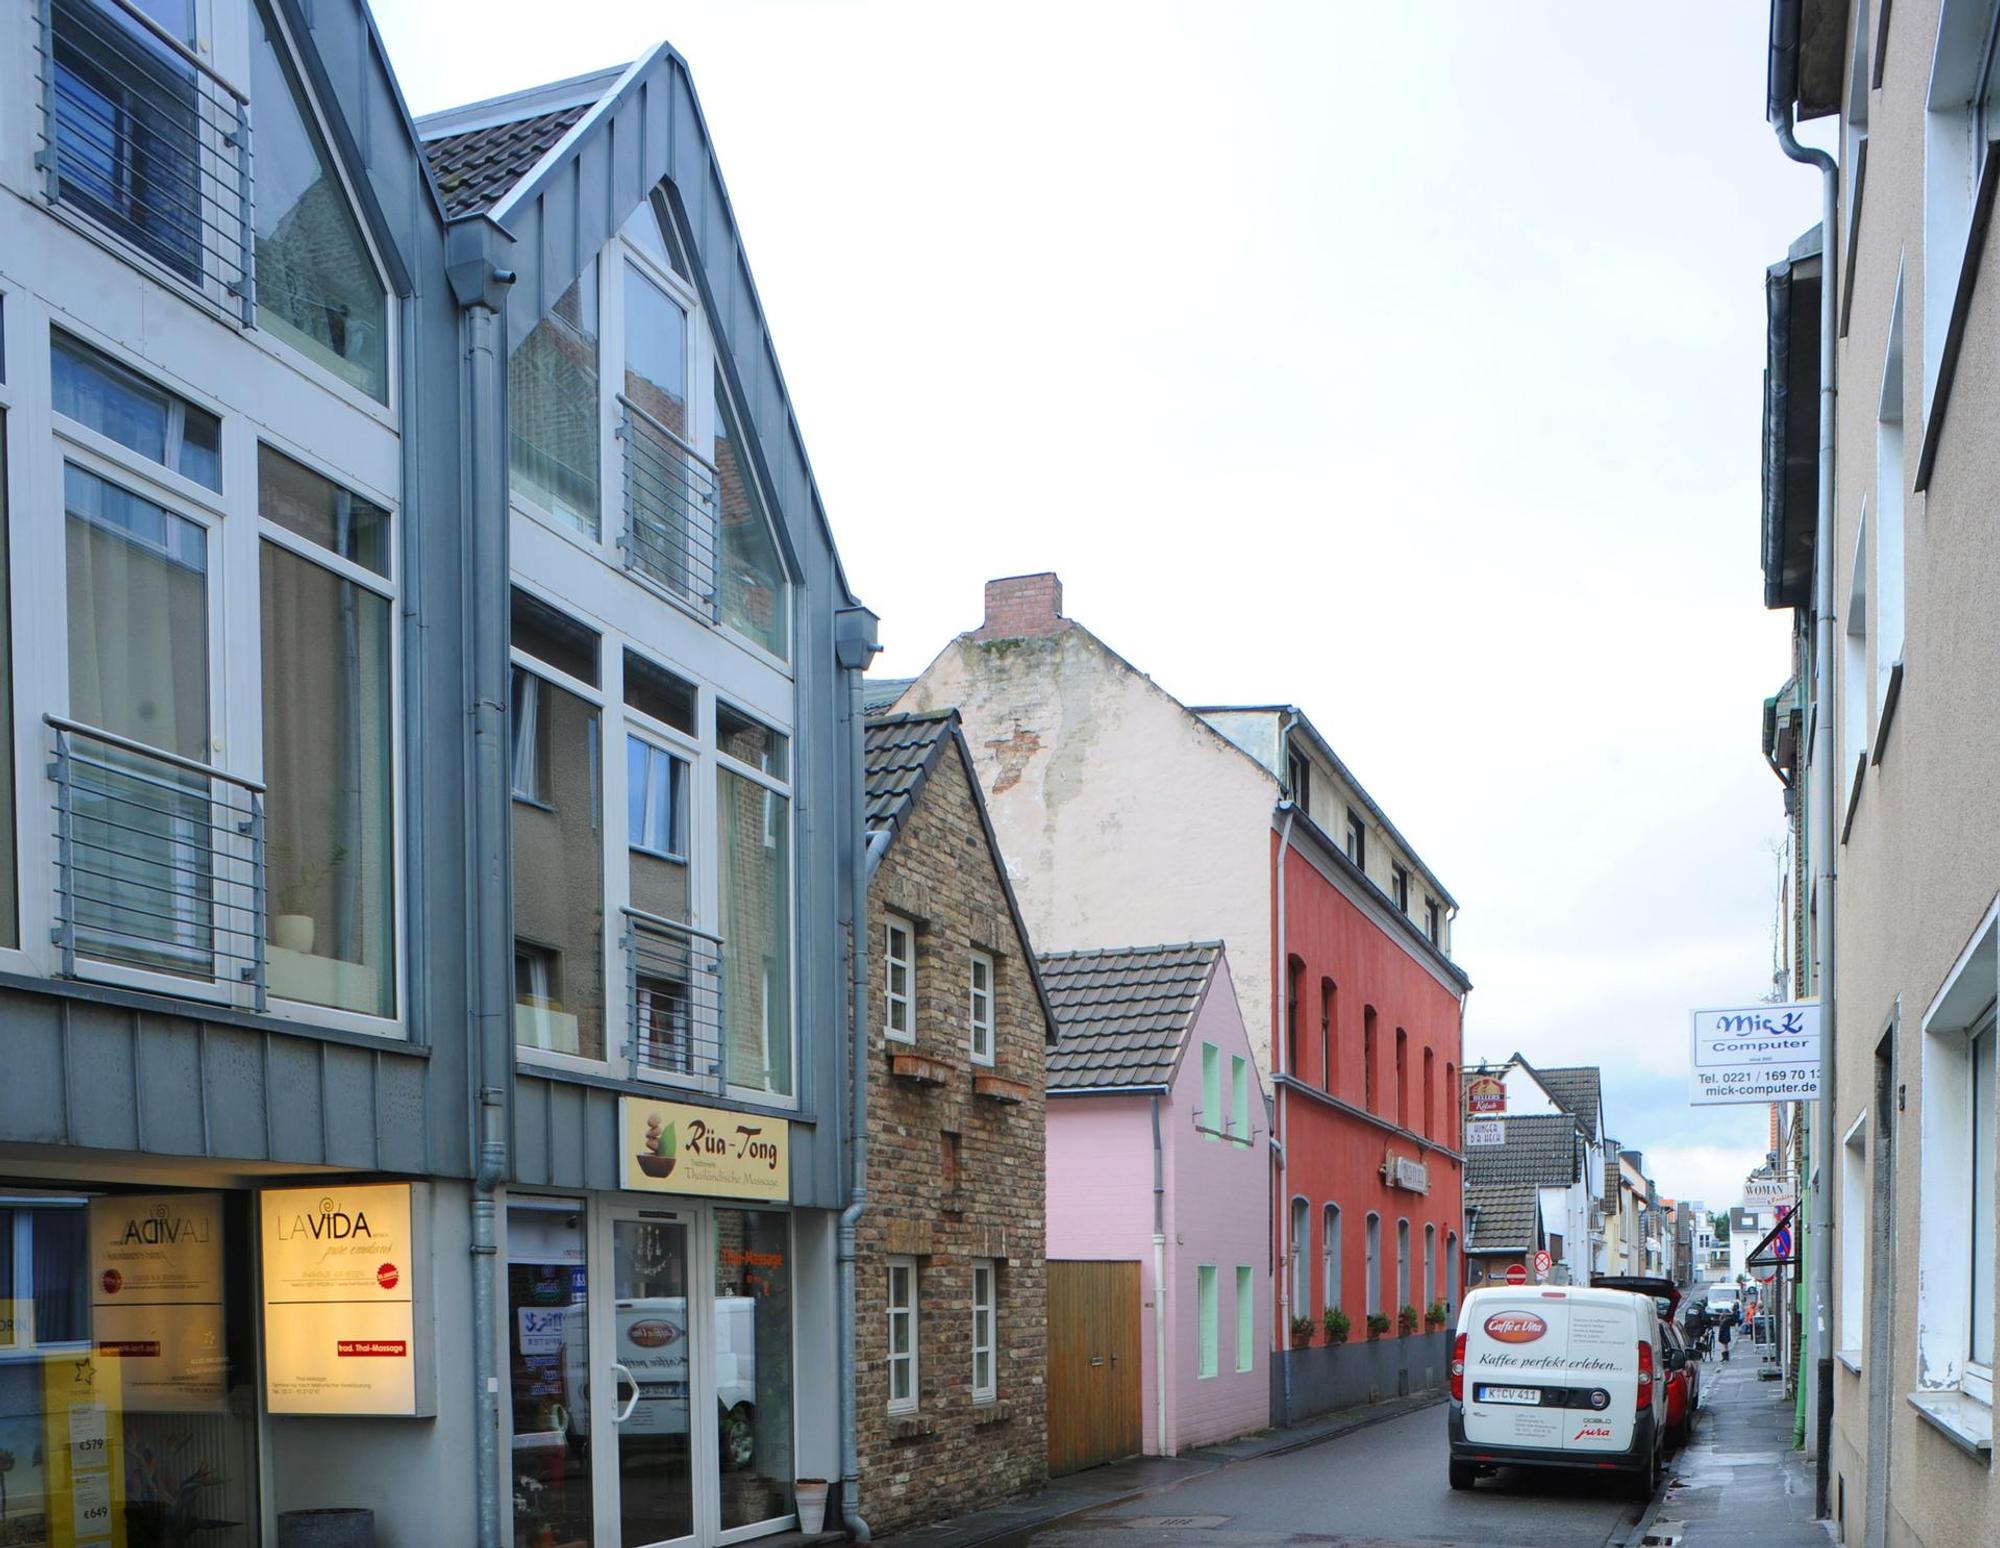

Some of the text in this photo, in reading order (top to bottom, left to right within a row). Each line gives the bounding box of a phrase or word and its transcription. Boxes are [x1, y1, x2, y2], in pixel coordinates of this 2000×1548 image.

[1712, 1039, 1810, 1052] Computer
[1698, 1073, 1719, 1084] Tel.
[1723, 1072, 1751, 1083] 0221
[1765, 1070, 1787, 1081] 169
[1791, 1069, 1806, 1080] 70
[1705, 1082, 1817, 1096] mick-computer.de
[685, 1119, 778, 1170] Rüa-Tong
[743, 1172, 779, 1191] Massage
[1745, 1184, 1784, 1195] WOMAN
[1521, 1321, 1543, 1333] Vita
[338, 1344, 404, 1354] trad. Thai-Massage
[1479, 1354, 1518, 1370] Kaffee
[1520, 1356, 1566, 1370] perfekt
[1488, 1388, 1536, 1400] K CV 411
[1574, 1424, 1611, 1441] jura
[79, 1438, 104, 1451] €579
